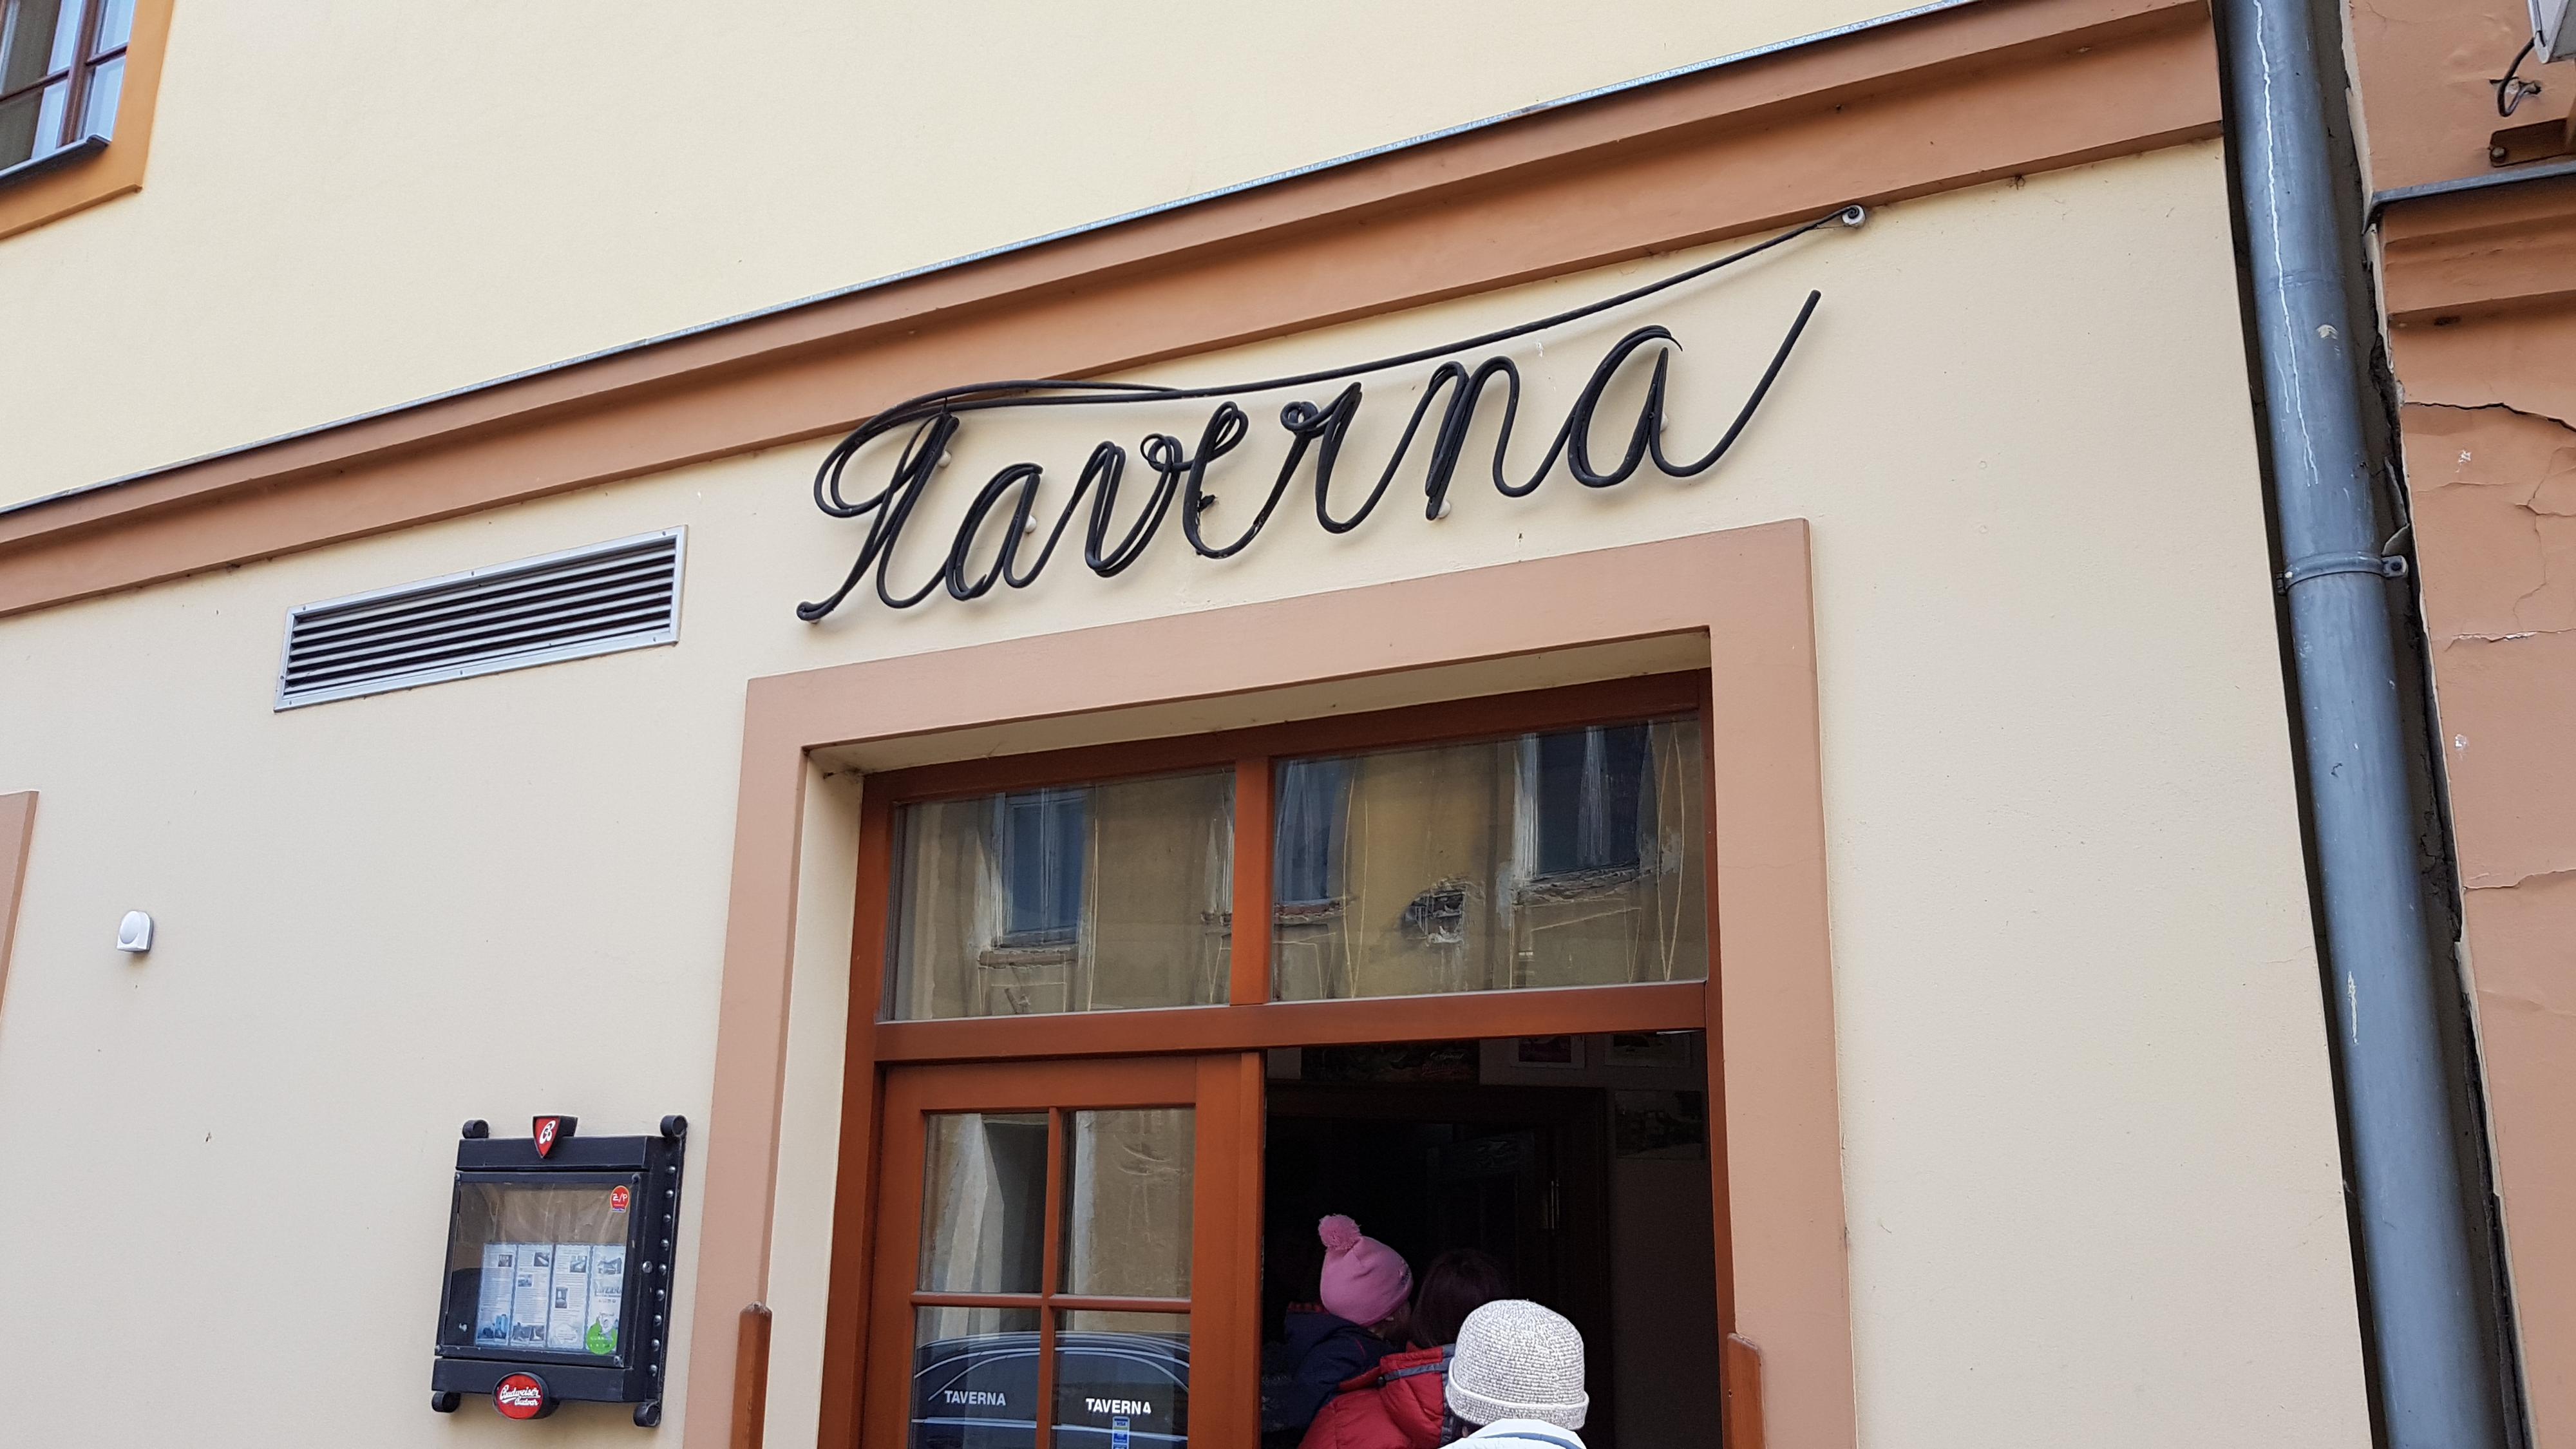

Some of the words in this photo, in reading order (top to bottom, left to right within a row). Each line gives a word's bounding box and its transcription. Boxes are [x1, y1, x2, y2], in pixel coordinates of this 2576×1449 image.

[797, 283, 1821, 622] Taverna
[500, 1384, 542, 1401] Budweiser
[944, 1390, 1006, 1405] TAVERNA
[1085, 1398, 1151, 1415] TAVERNA
